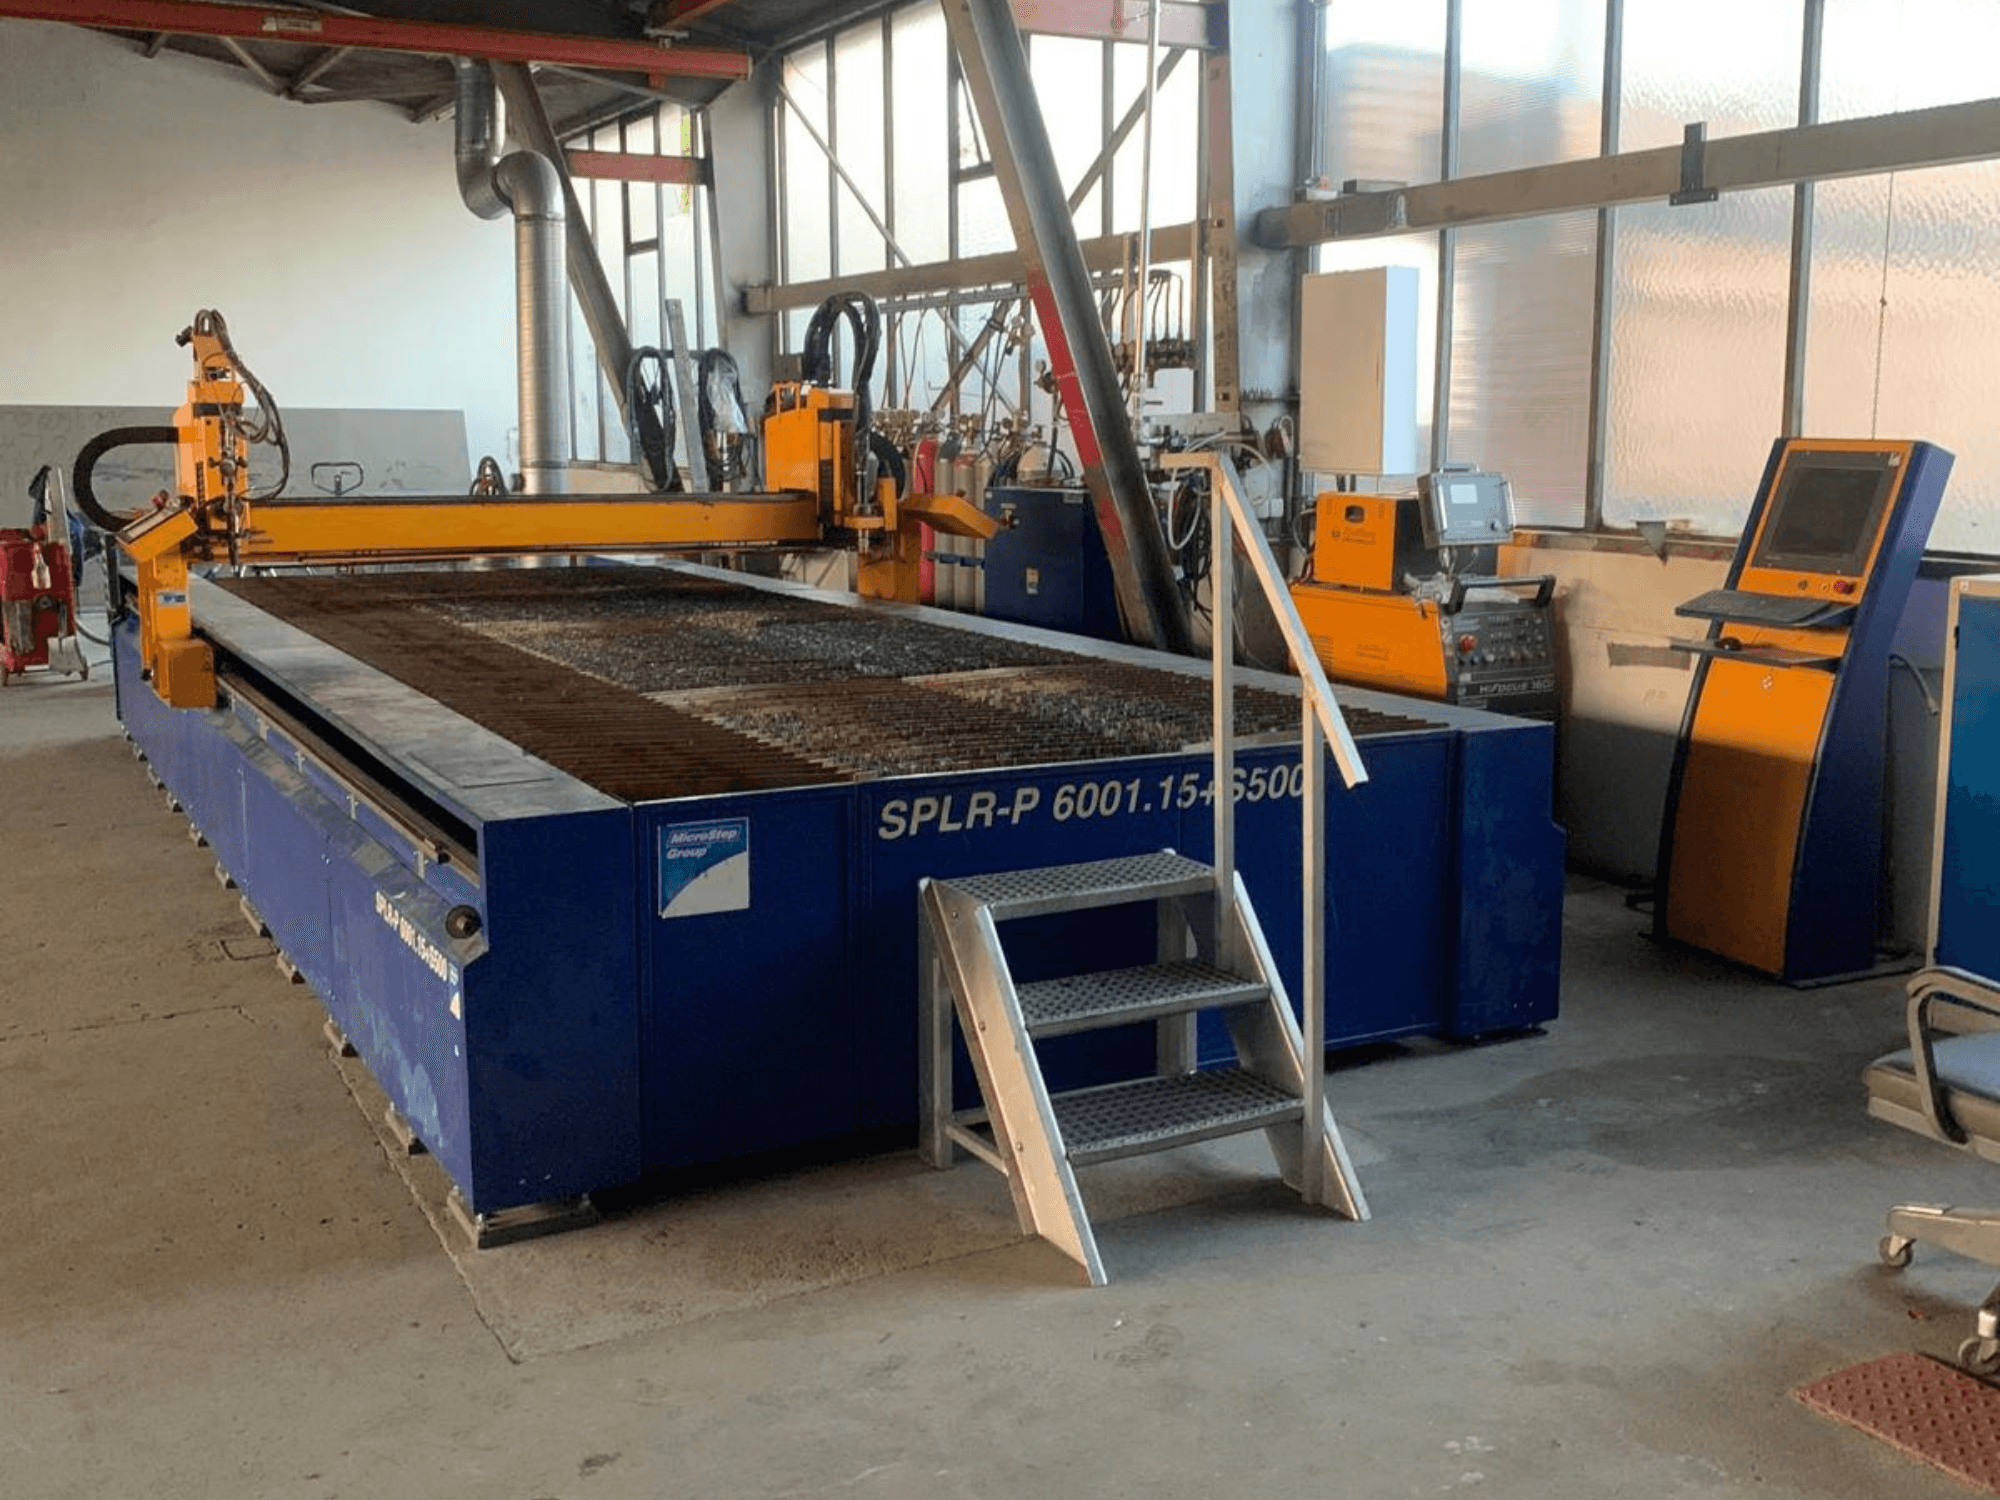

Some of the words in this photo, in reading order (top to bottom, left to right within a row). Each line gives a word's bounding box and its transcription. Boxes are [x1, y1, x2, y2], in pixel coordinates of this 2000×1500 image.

[878, 787, 1040, 839] SPLR-P
[671, 829, 738, 844] MicroStep
[666, 847, 708, 859] Group
